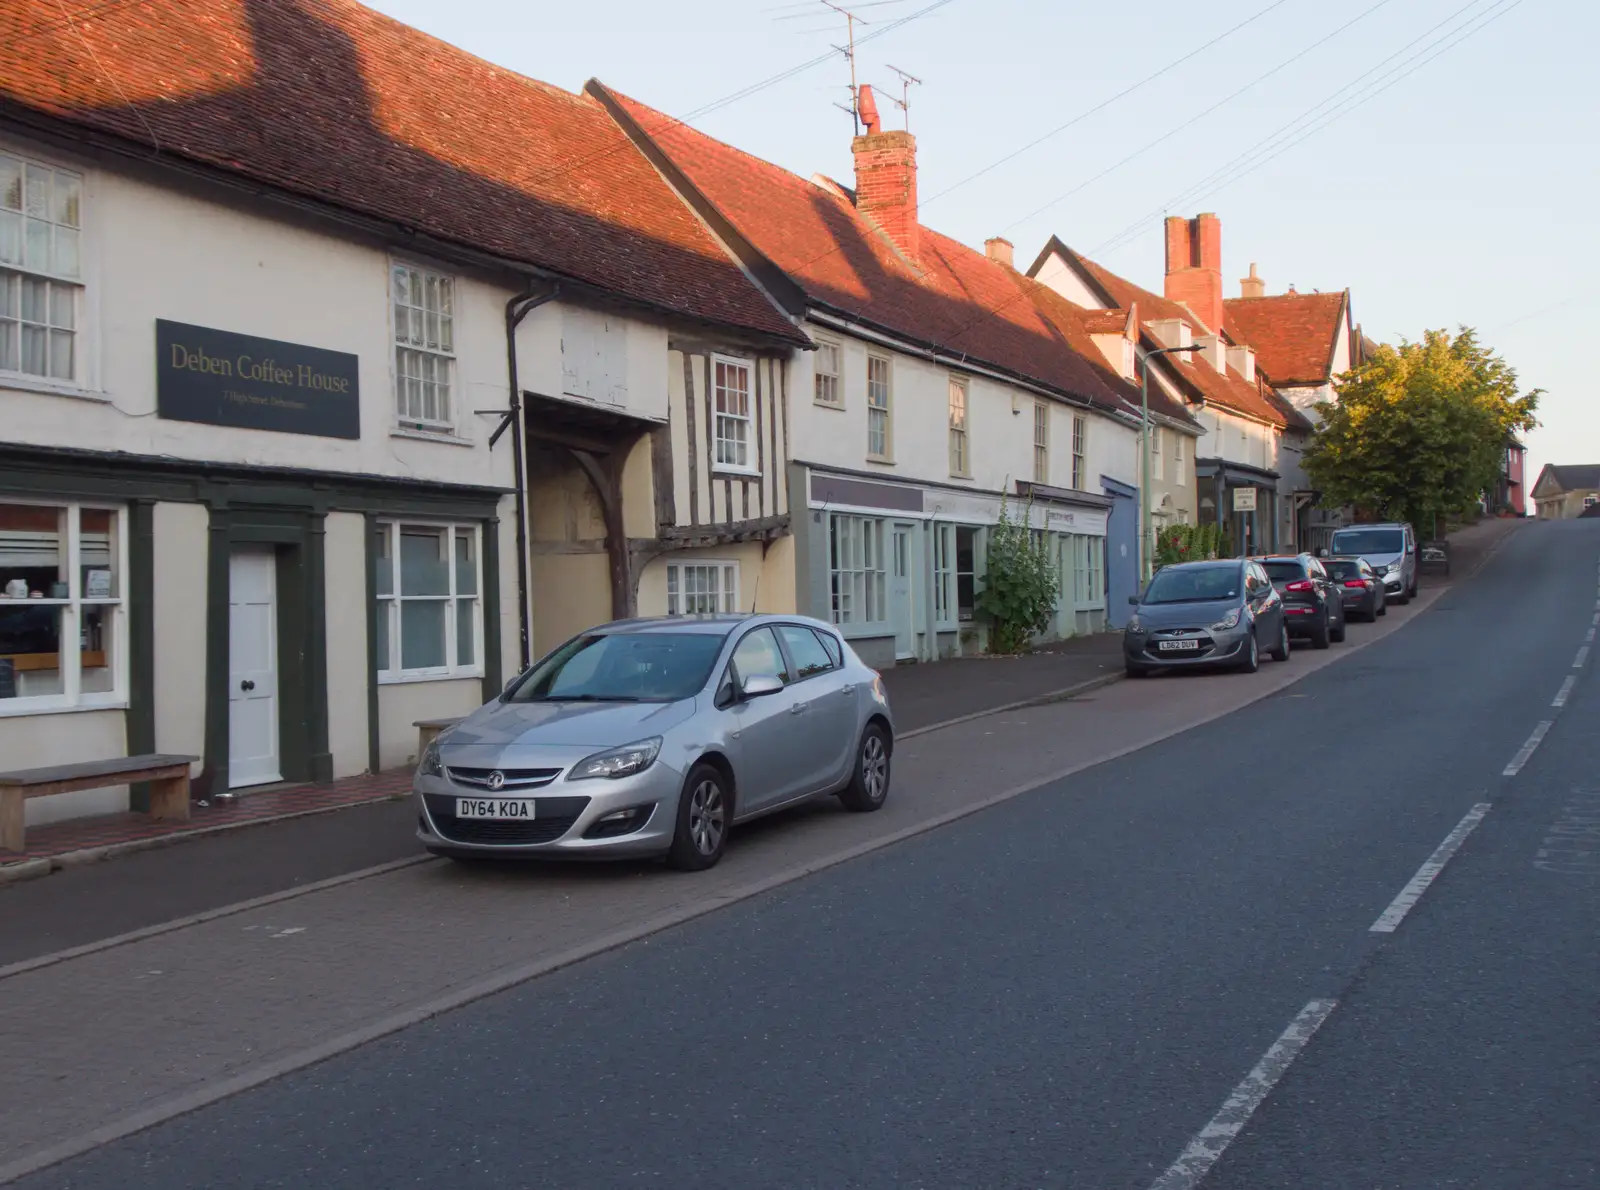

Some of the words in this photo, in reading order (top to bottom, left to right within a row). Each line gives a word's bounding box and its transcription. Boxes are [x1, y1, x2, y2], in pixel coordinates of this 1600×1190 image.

[171, 343, 232, 376] Deben
[237, 355, 293, 386] Coffee
[297, 364, 349, 393] House
[461, 800, 496, 816] DY64
[499, 801, 528, 817] KOA
